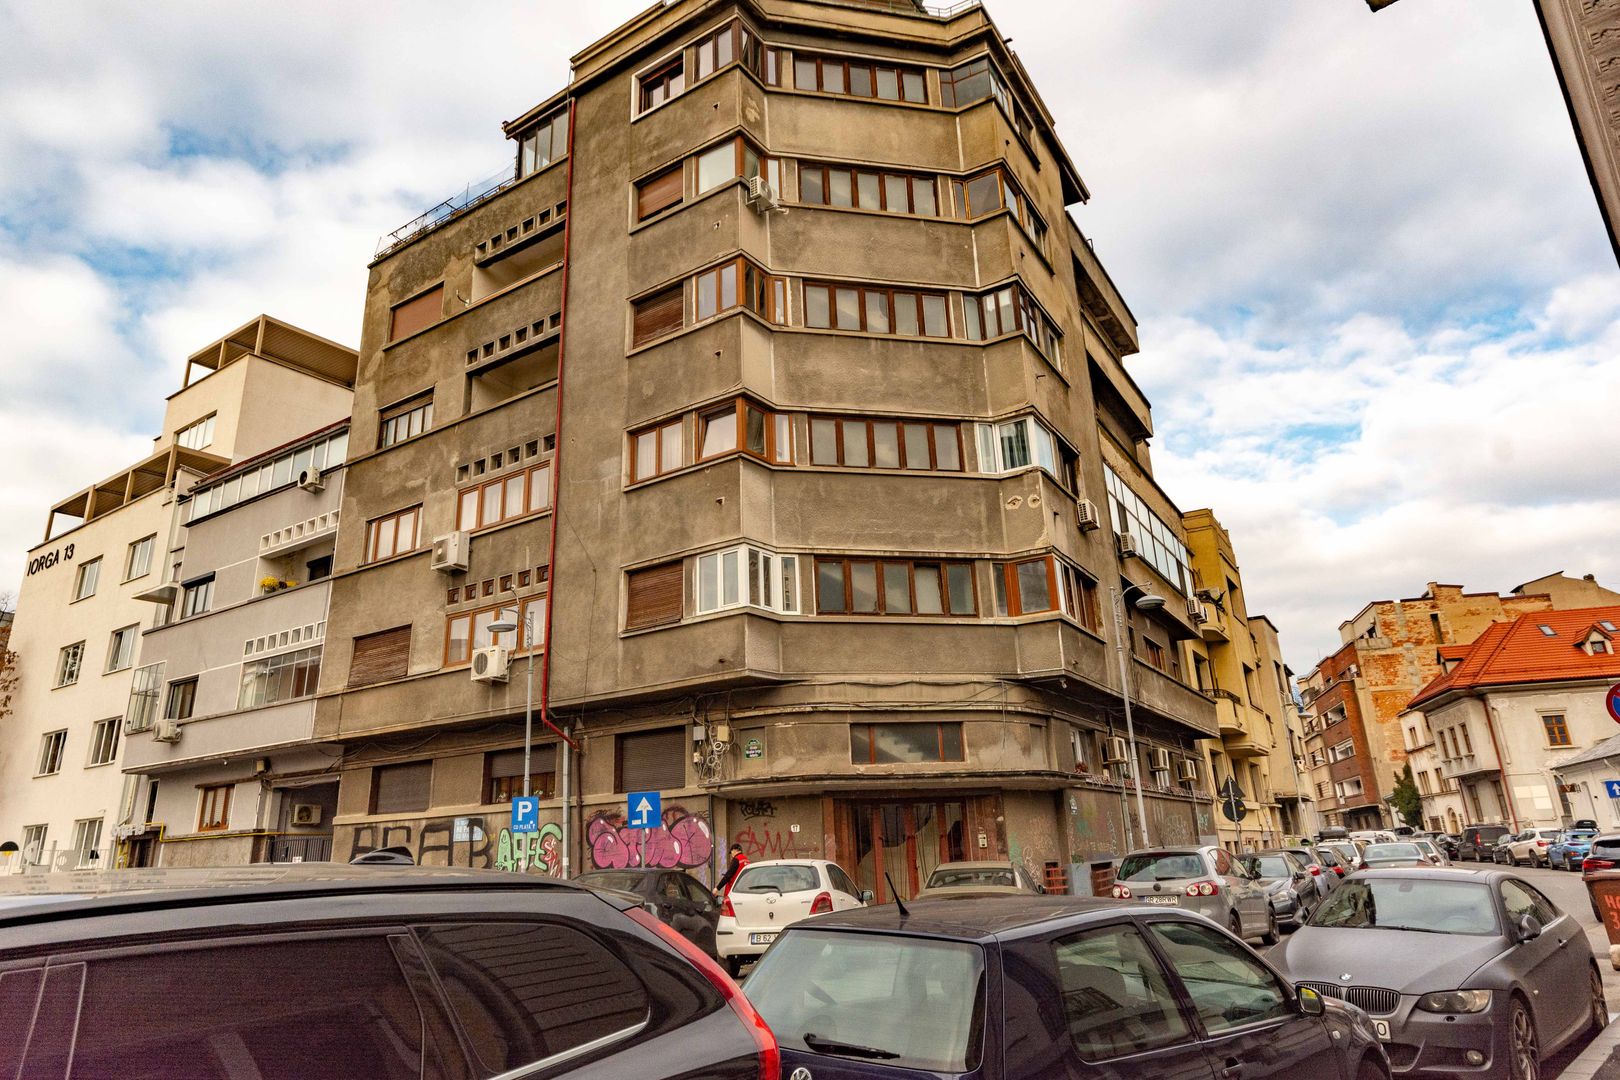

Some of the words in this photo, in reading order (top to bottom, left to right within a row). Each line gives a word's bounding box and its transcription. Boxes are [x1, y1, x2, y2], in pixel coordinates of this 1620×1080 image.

[27, 549, 60, 577] IORGA
[63, 543, 75, 561] 13
[517, 801, 533, 822] P
